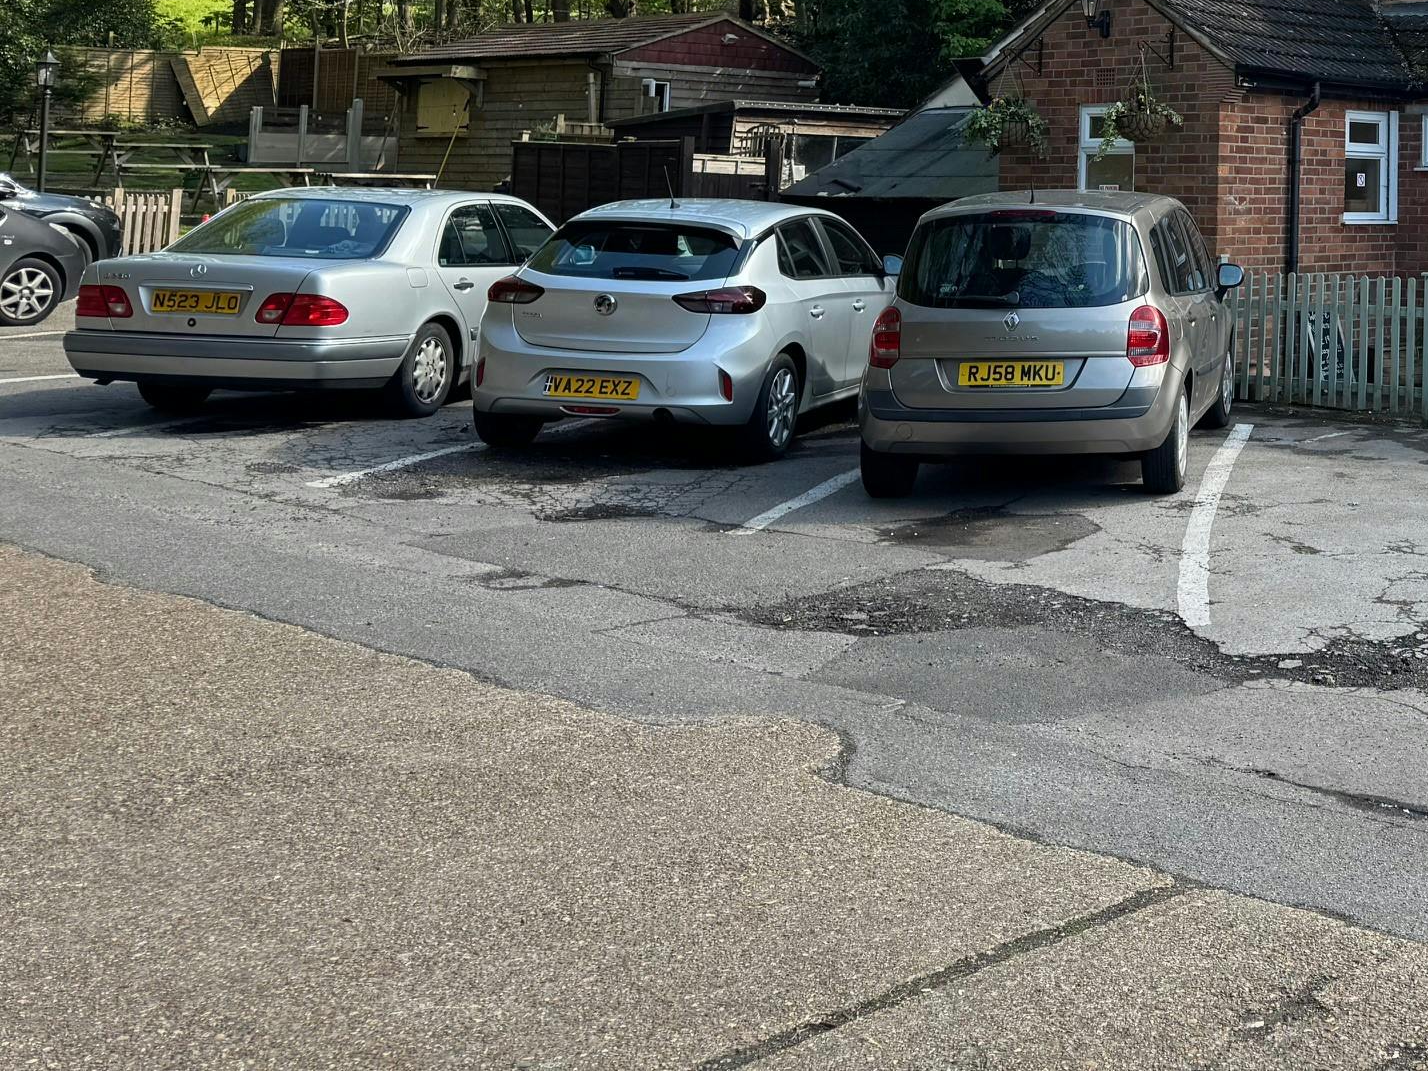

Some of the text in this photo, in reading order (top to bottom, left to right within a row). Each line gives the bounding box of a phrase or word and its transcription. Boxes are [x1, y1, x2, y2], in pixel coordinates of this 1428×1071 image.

[153, 292, 239, 311] N523 JLO
[967, 363, 1057, 382] RJ58 MKU
[553, 377, 633, 396] VA22 EXZ
